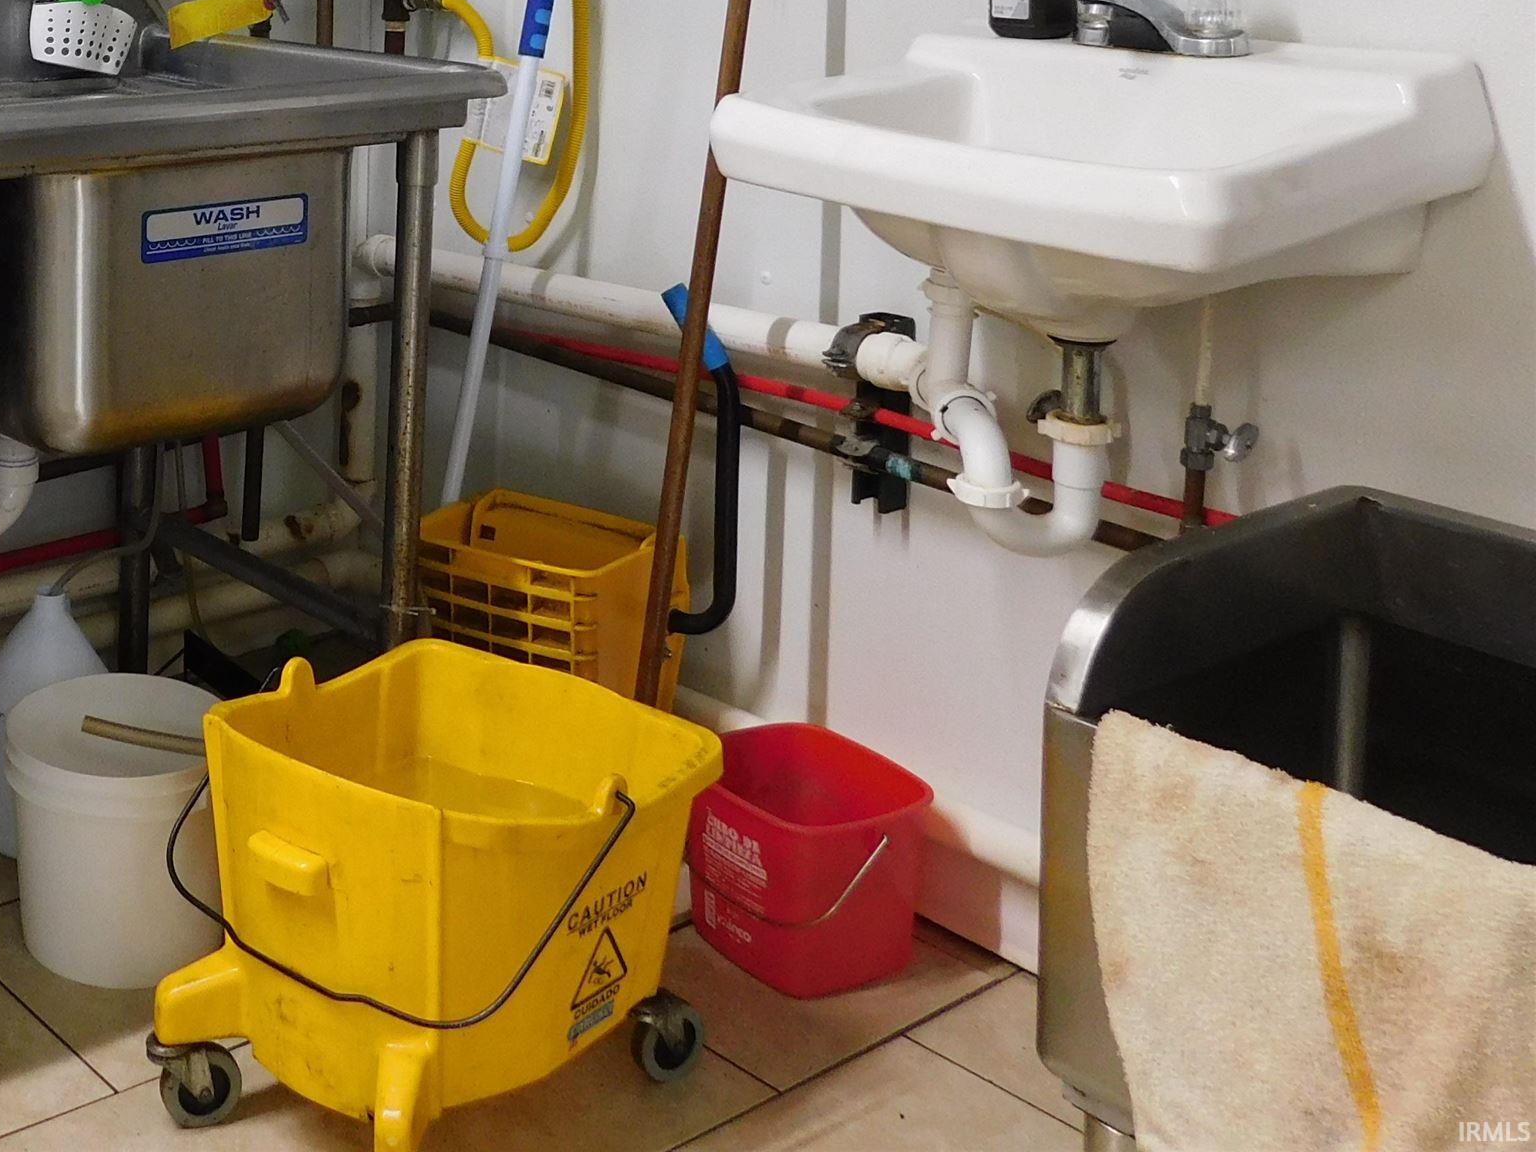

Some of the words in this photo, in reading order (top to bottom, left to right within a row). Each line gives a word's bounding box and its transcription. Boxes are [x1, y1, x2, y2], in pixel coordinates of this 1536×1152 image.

[192, 204, 261, 226] WASH
[217, 221, 238, 231] Lavar
[567, 871, 648, 931] CAUTION
[573, 984, 621, 1020] CUIDADO
